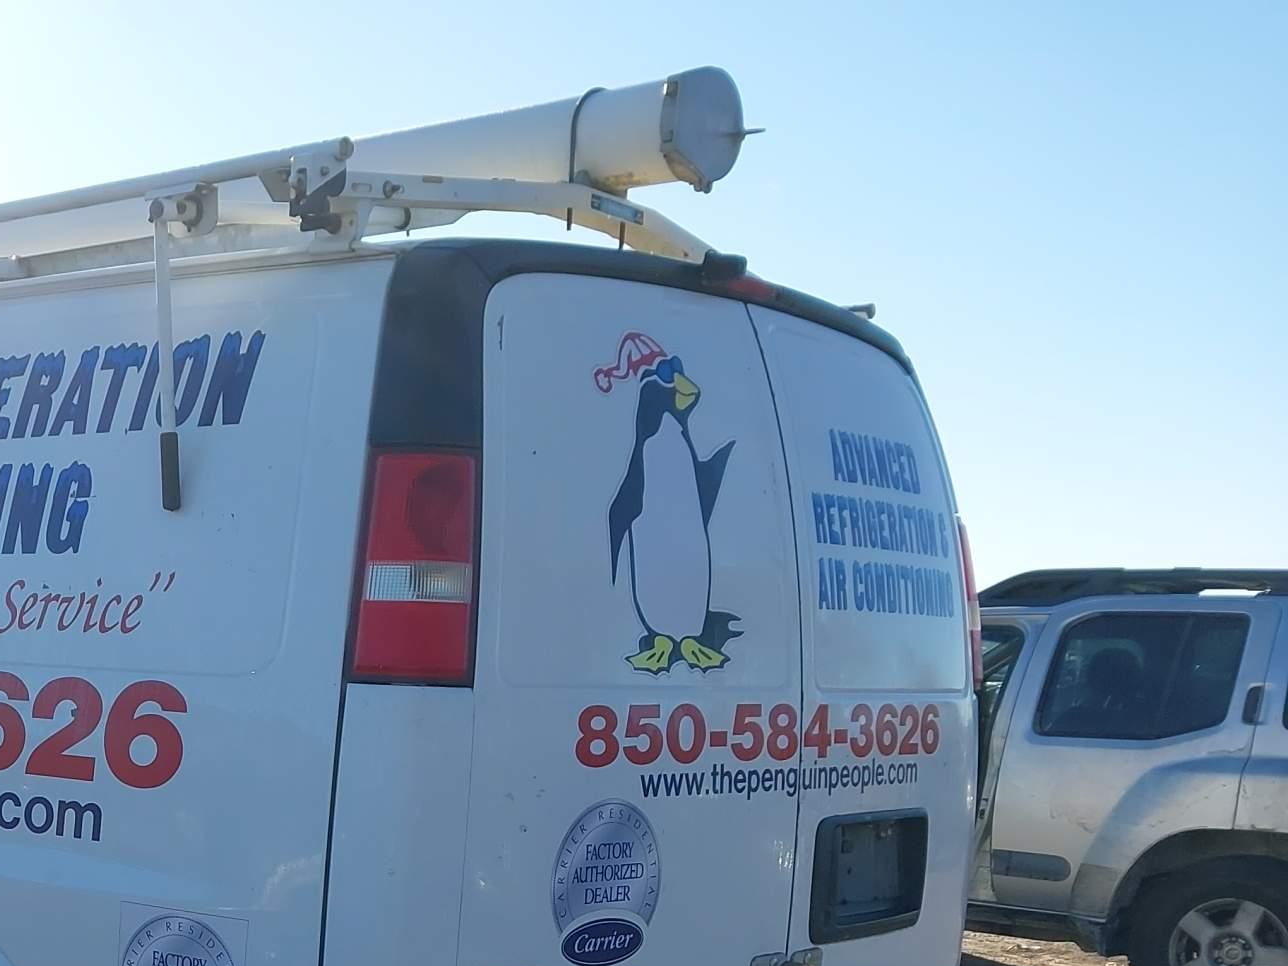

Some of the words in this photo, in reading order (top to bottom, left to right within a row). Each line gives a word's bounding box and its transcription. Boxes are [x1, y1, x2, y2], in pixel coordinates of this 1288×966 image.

[829, 428, 921, 495] ADVANCED
[812, 491, 937, 558] REFRIGERATION
[938, 511, 949, 558] &
[818, 556, 848, 611] AIR
[852, 558, 955, 619] CONDITIONING
[574, 702, 941, 769] 850-584-3626
[640, 756, 919, 800] www.thepenguinpeople.com
[557, 823, 588, 919] CARRIER
[573, 862, 645, 884] AUTHORIZED
[585, 841, 634, 861] FACTORY
[584, 885, 631, 905] DEALER
[574, 931, 634, 954] Carrier
